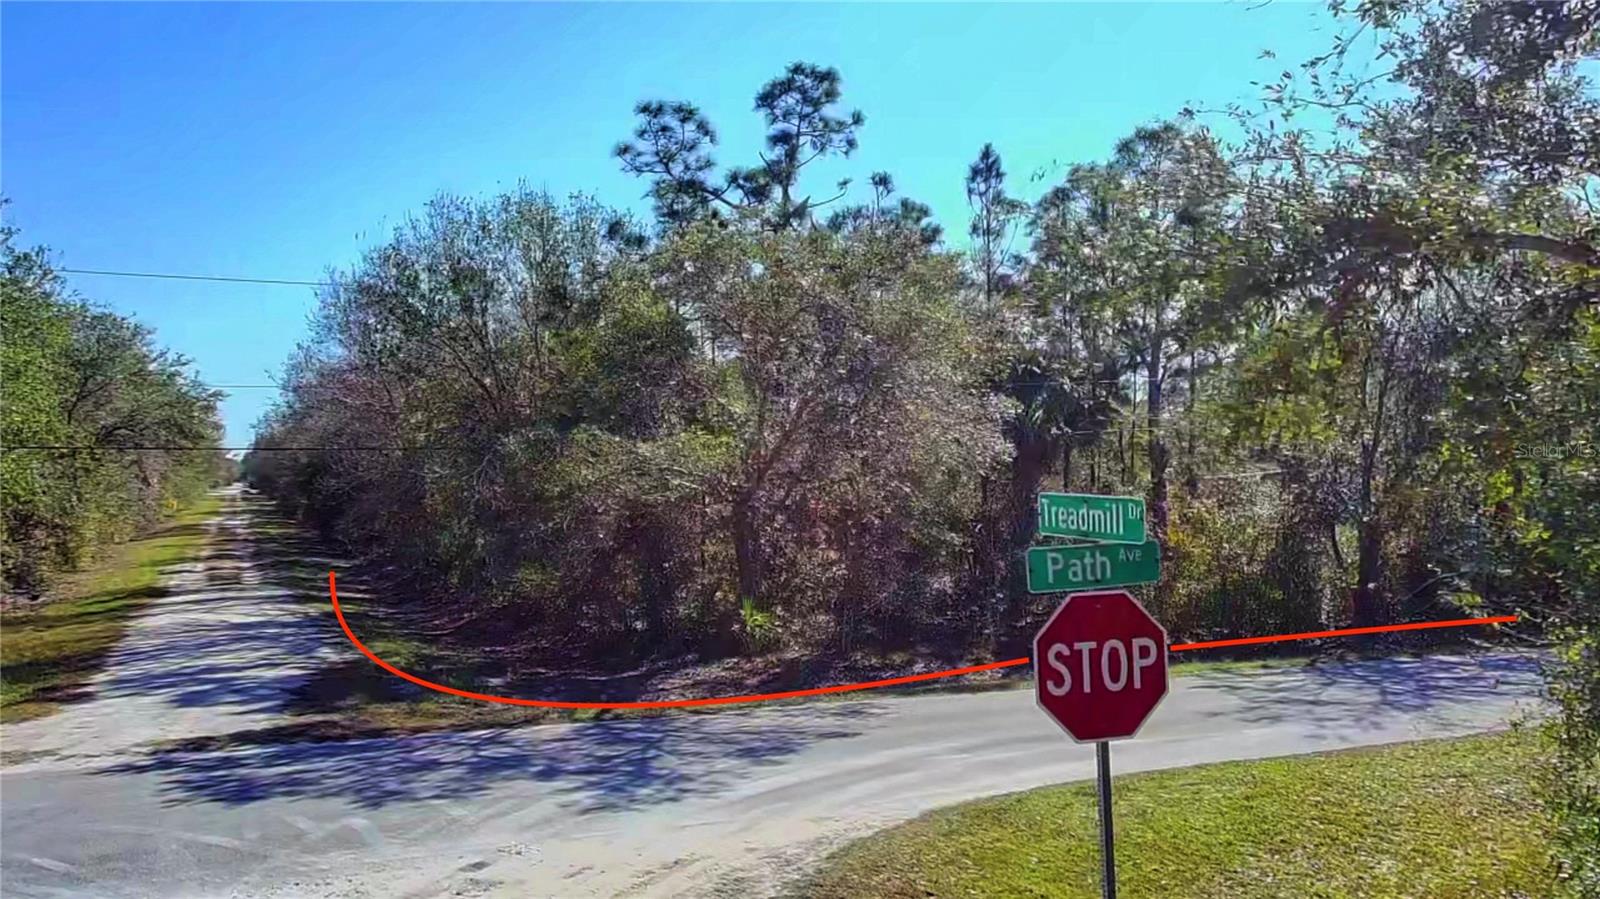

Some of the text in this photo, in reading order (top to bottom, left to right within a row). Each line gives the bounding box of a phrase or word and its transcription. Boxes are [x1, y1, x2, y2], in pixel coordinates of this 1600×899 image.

[1041, 498, 1142, 535] Treadmill Dr
[1046, 547, 1142, 584] Path Ave
[1046, 637, 1158, 696] STOP
